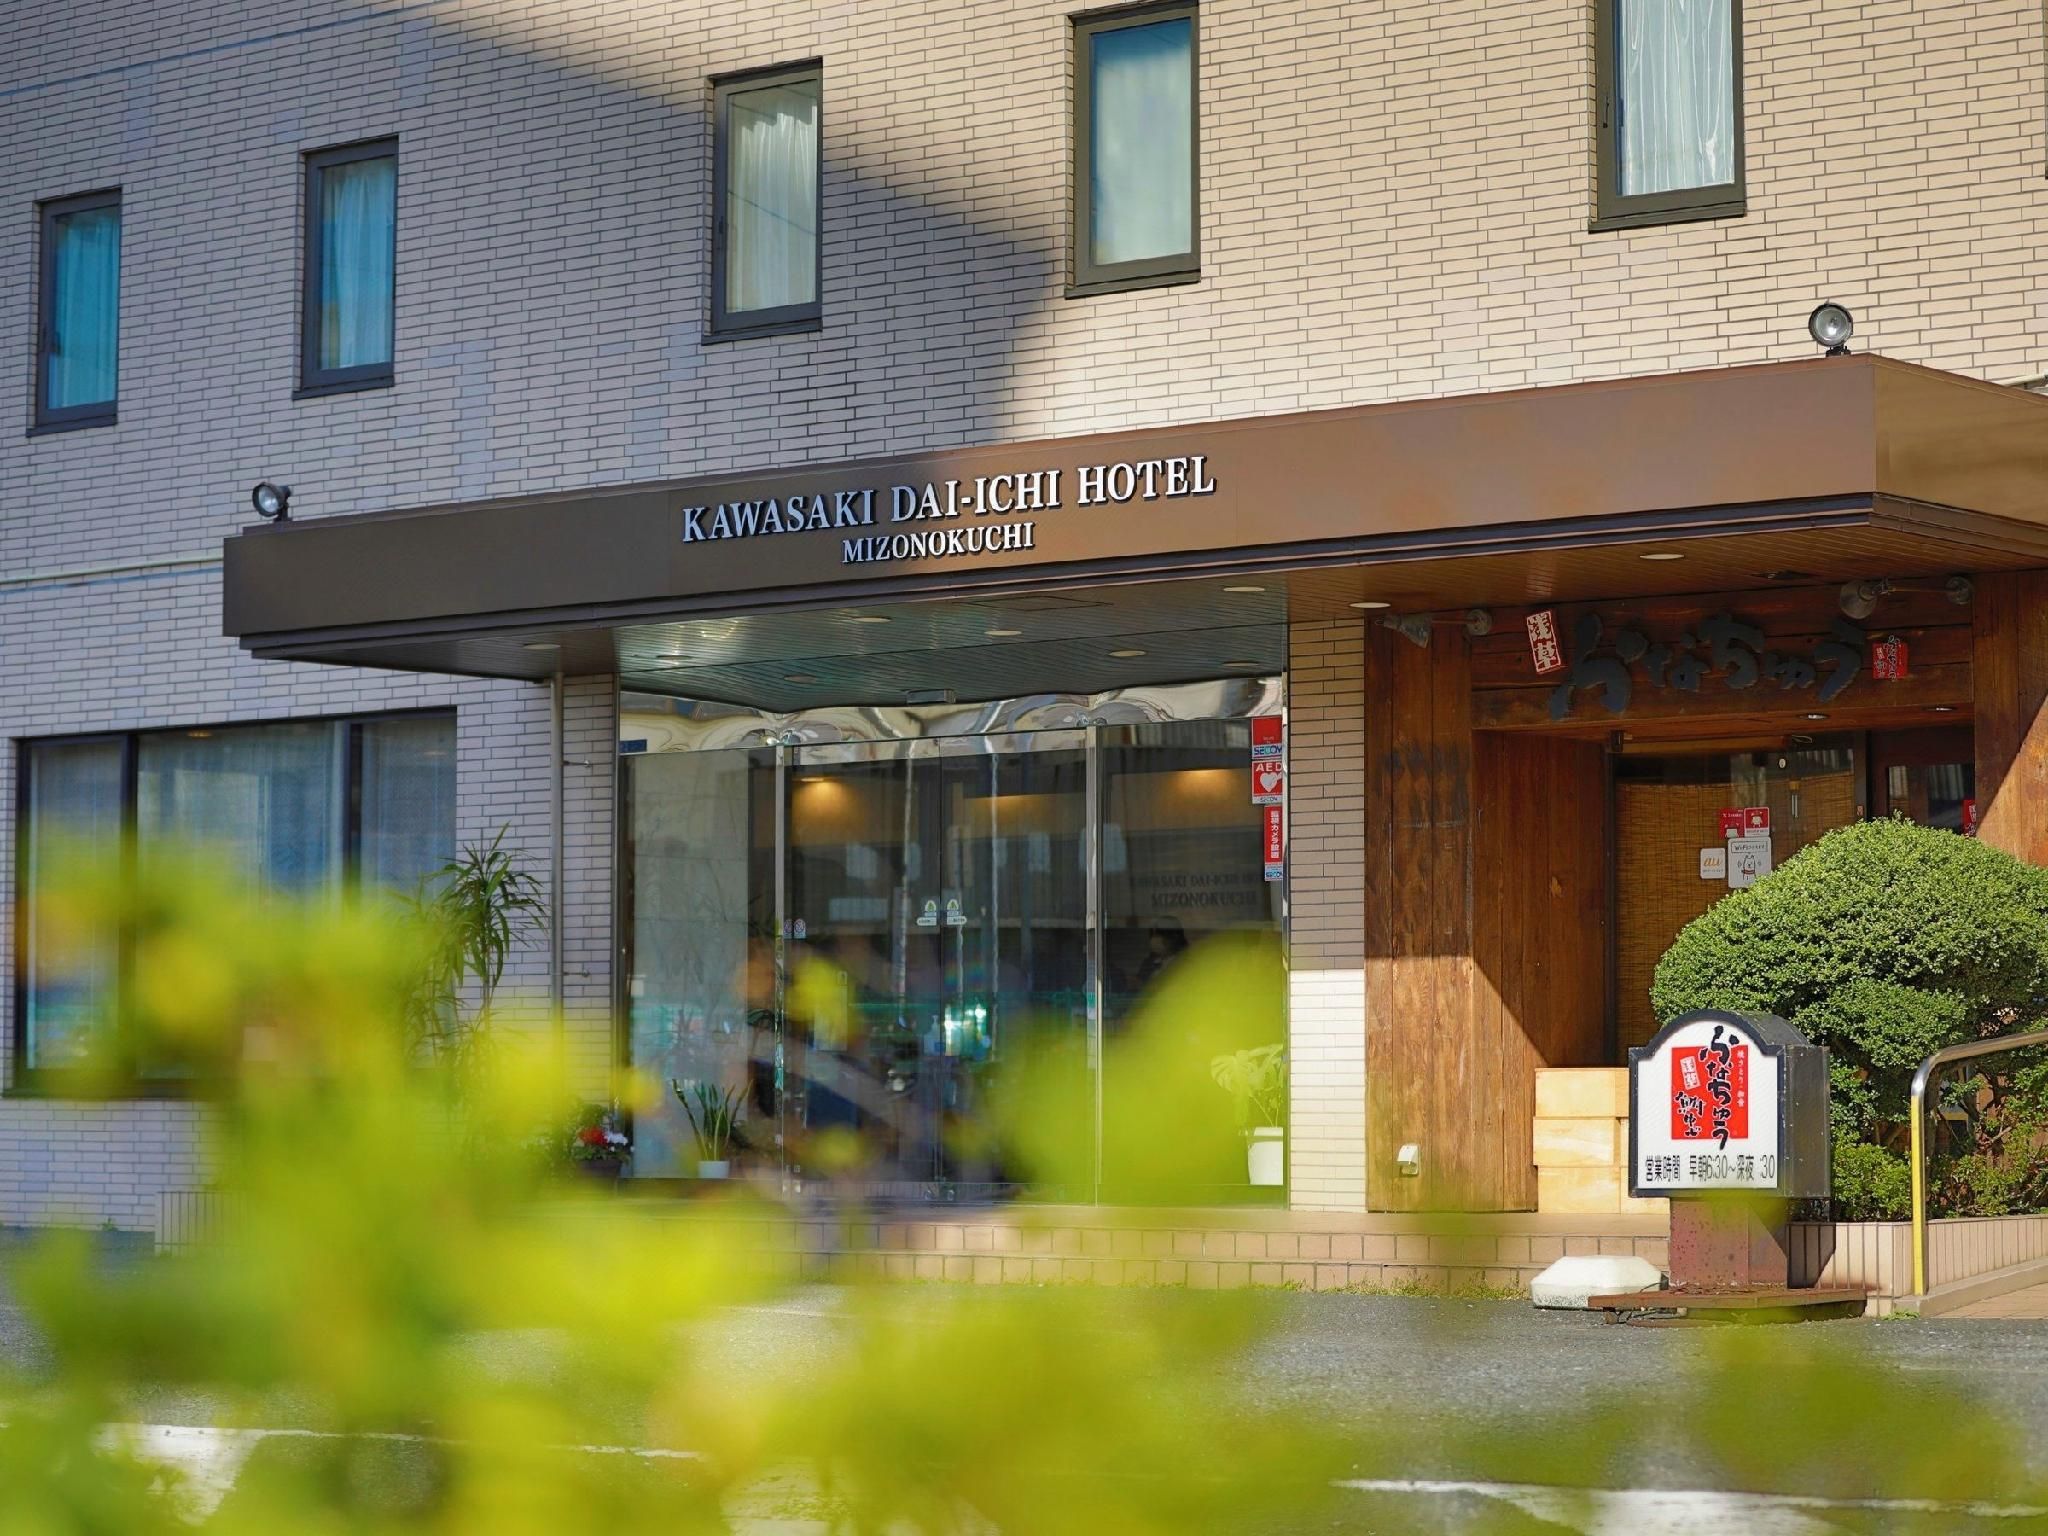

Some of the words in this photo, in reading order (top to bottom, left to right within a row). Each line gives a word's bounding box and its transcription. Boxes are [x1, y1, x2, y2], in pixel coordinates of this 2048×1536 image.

[683, 489, 877, 543] KAWASAKI
[891, 470, 1062, 523] DAI-ICHI
[1077, 456, 1215, 505] HOTEL
[842, 522, 1035, 564] MIZONOKUCHI
[1527, 610, 1562, 674] 浅草
[1256, 762, 1282, 772] AED
[1703, 857, 1721, 867] au
[1645, 1155, 1681, 1182] 営業時間
